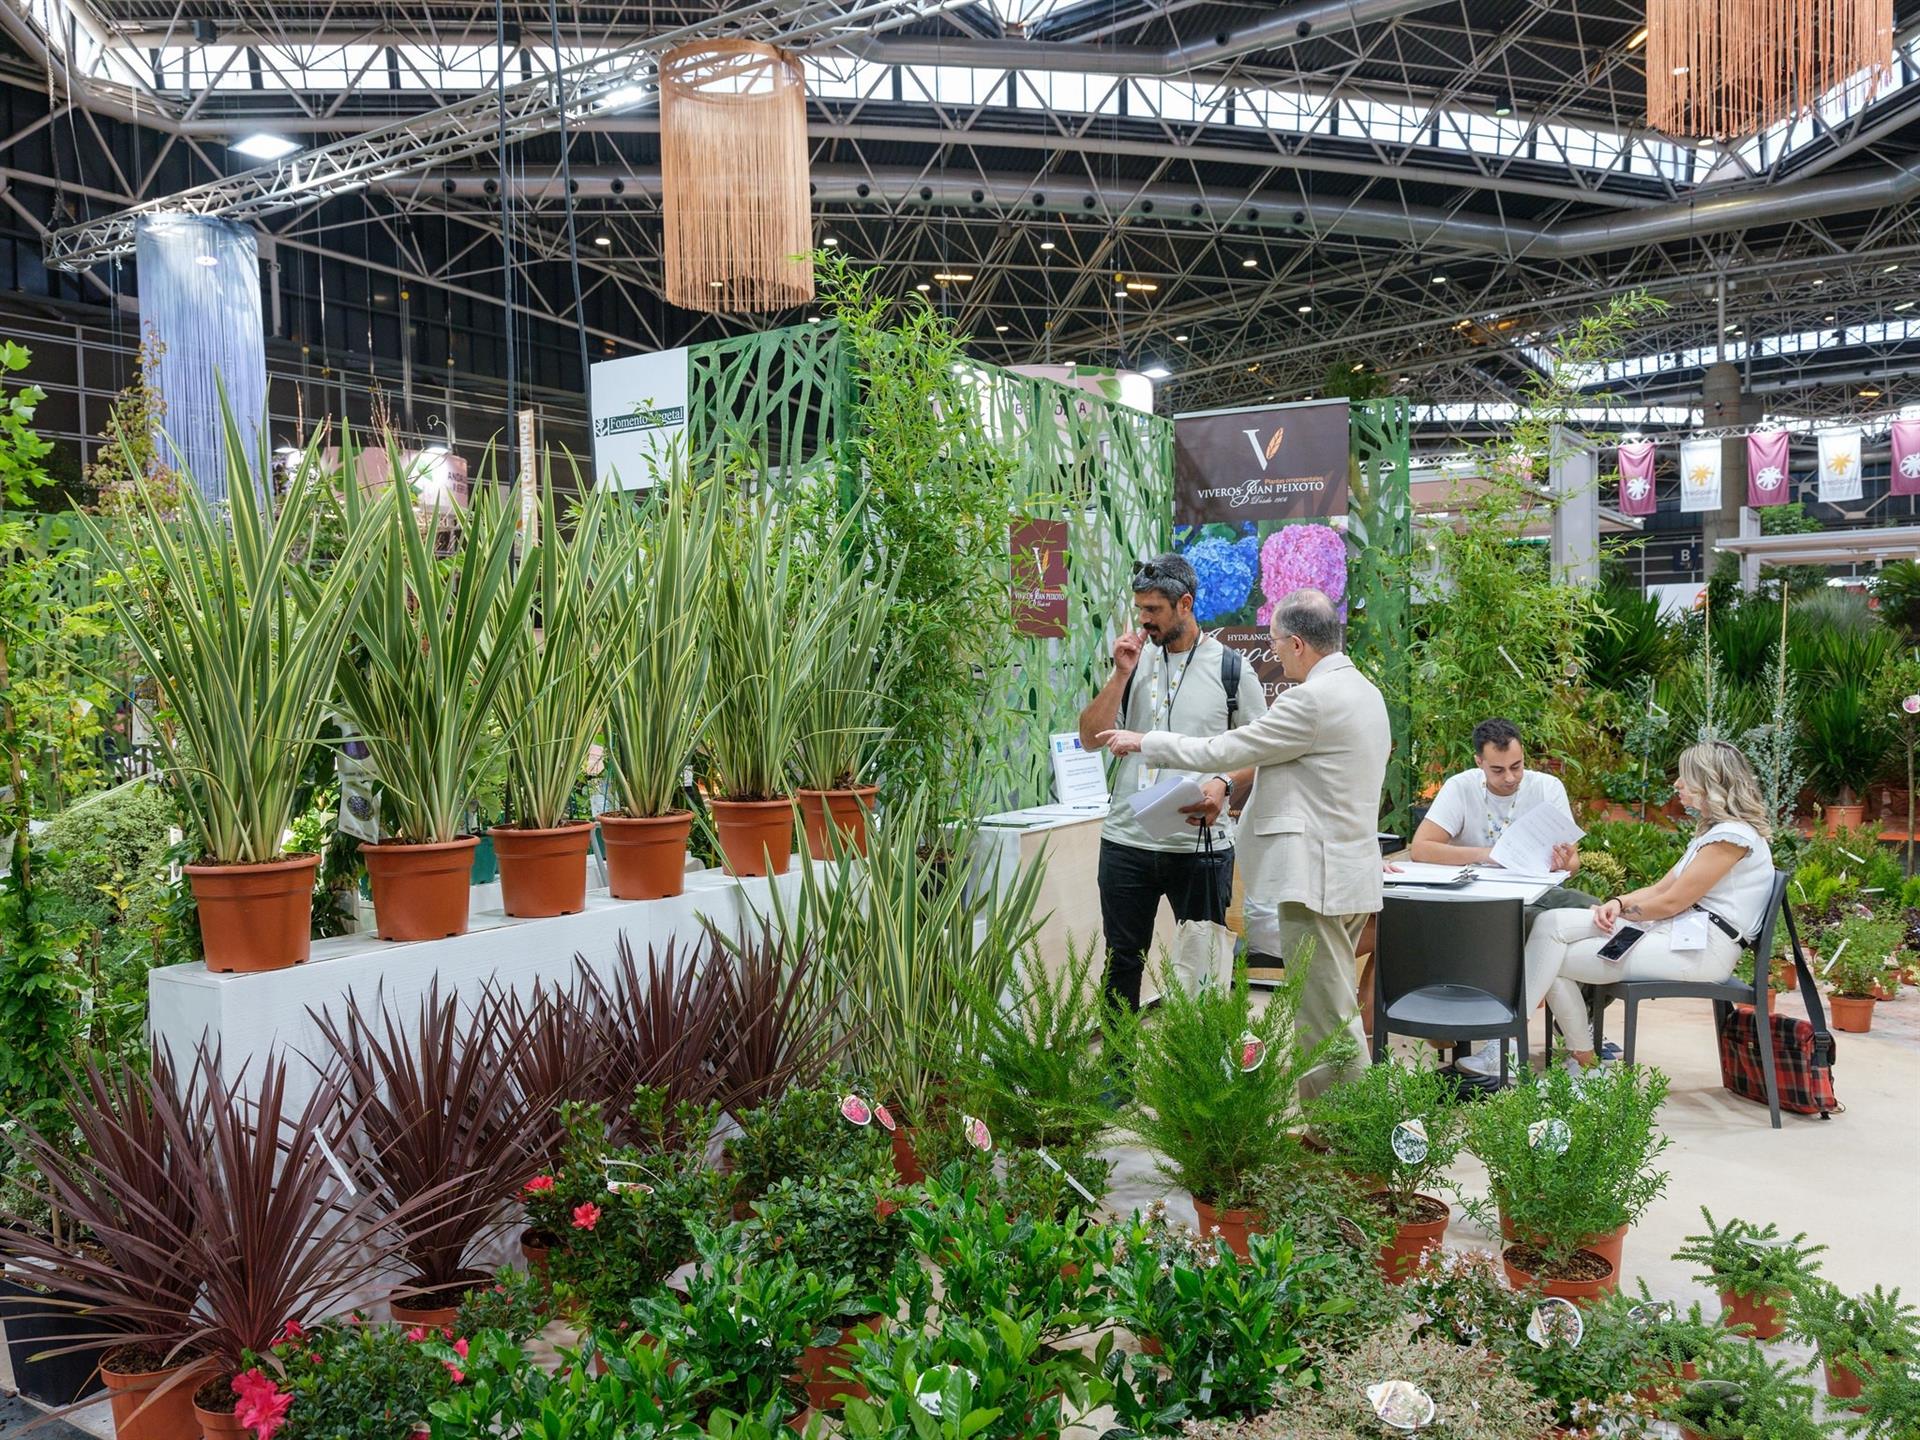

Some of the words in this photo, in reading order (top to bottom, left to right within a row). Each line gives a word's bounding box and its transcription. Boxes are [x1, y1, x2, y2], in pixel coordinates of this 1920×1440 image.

[610, 416, 648, 430] Fomento
[649, 408, 683, 424] Vgetal
[1197, 486, 1243, 499] VIVEROS
[1276, 481, 1325, 493] PEIXOTO
[1681, 549, 1690, 561] B
